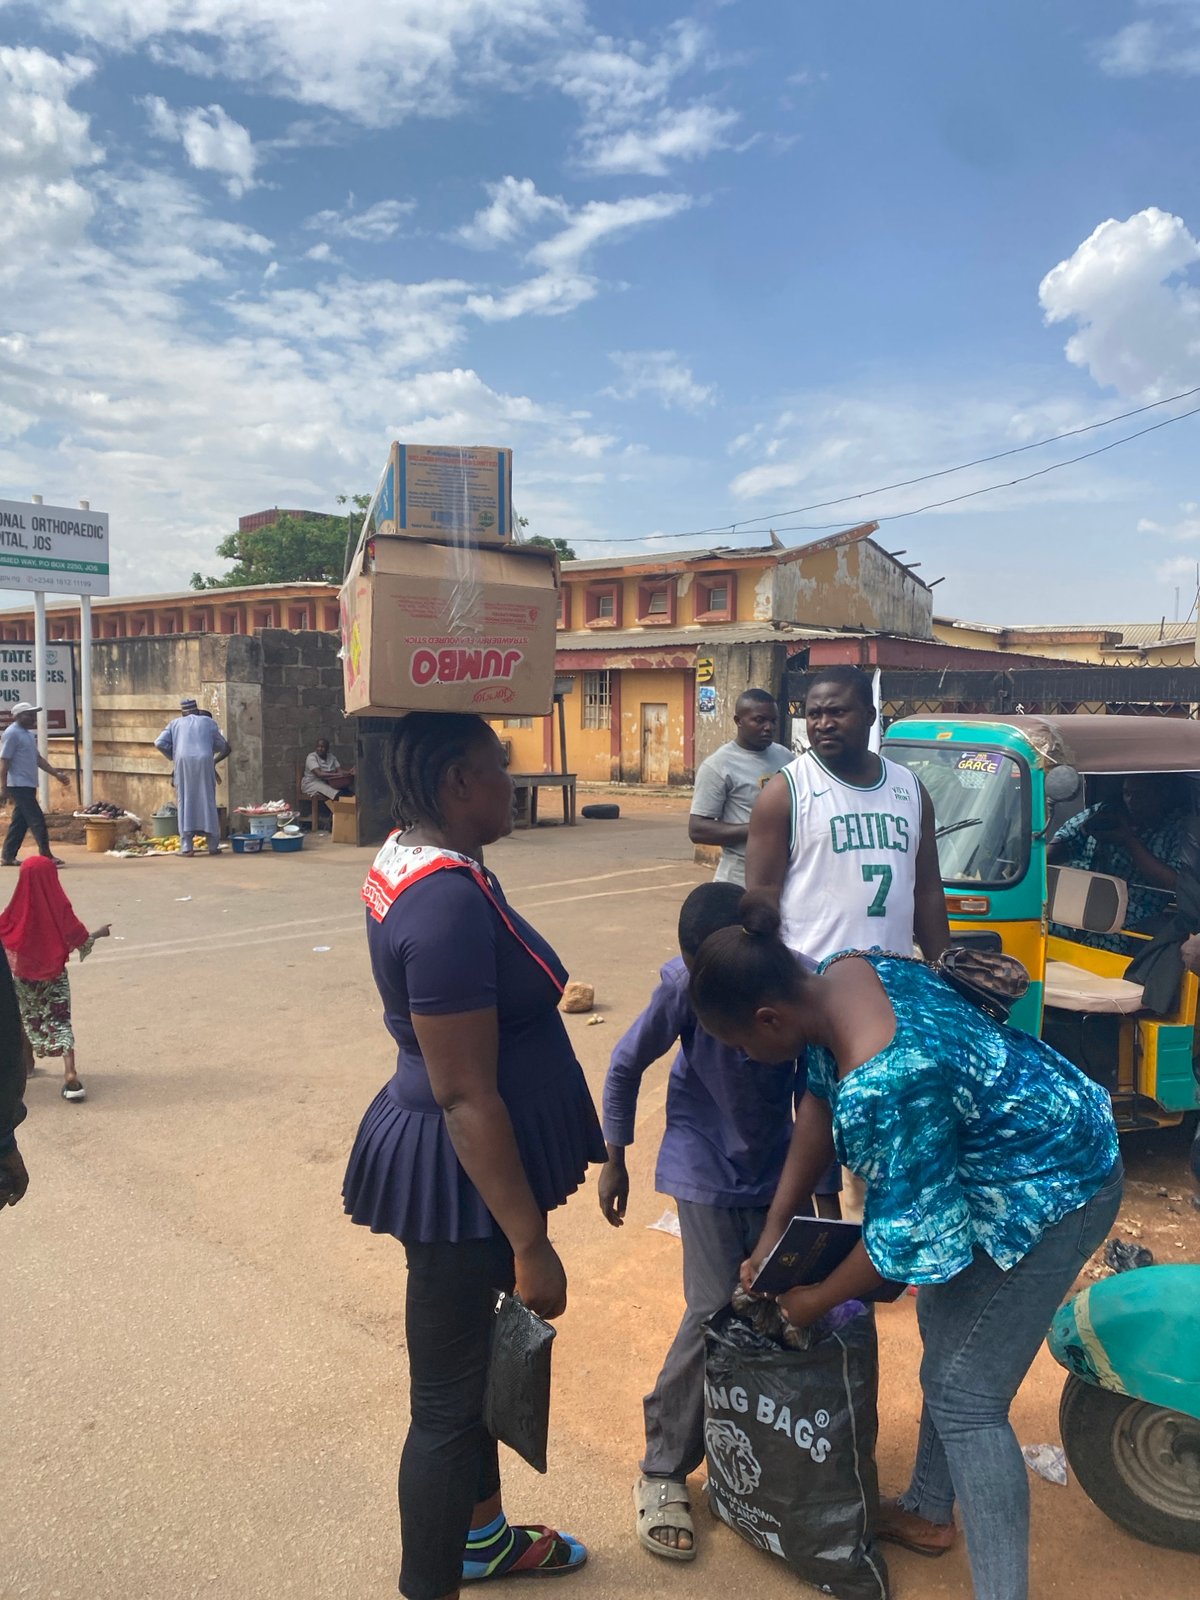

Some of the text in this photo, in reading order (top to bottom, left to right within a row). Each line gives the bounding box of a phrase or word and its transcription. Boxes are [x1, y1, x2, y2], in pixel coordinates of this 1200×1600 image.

[32, 516, 104, 539] ORTHOPAEDIC
[0, 530, 51, 551] ITAL, JOS
[84, 564, 98, 572] JOS
[404, 637, 426, 645] STICK
[0, 650, 32, 663] TATE
[410, 648, 523, 686] JUMBO
[11, 669, 67, 683] SCIECES,
[958, 760, 998, 773] GRACE
[830, 812, 909, 854] CELTICS
[861, 864, 893, 917] 7
[704, 1380, 749, 1414] ING
[729, 1501, 758, 1523] KANO
